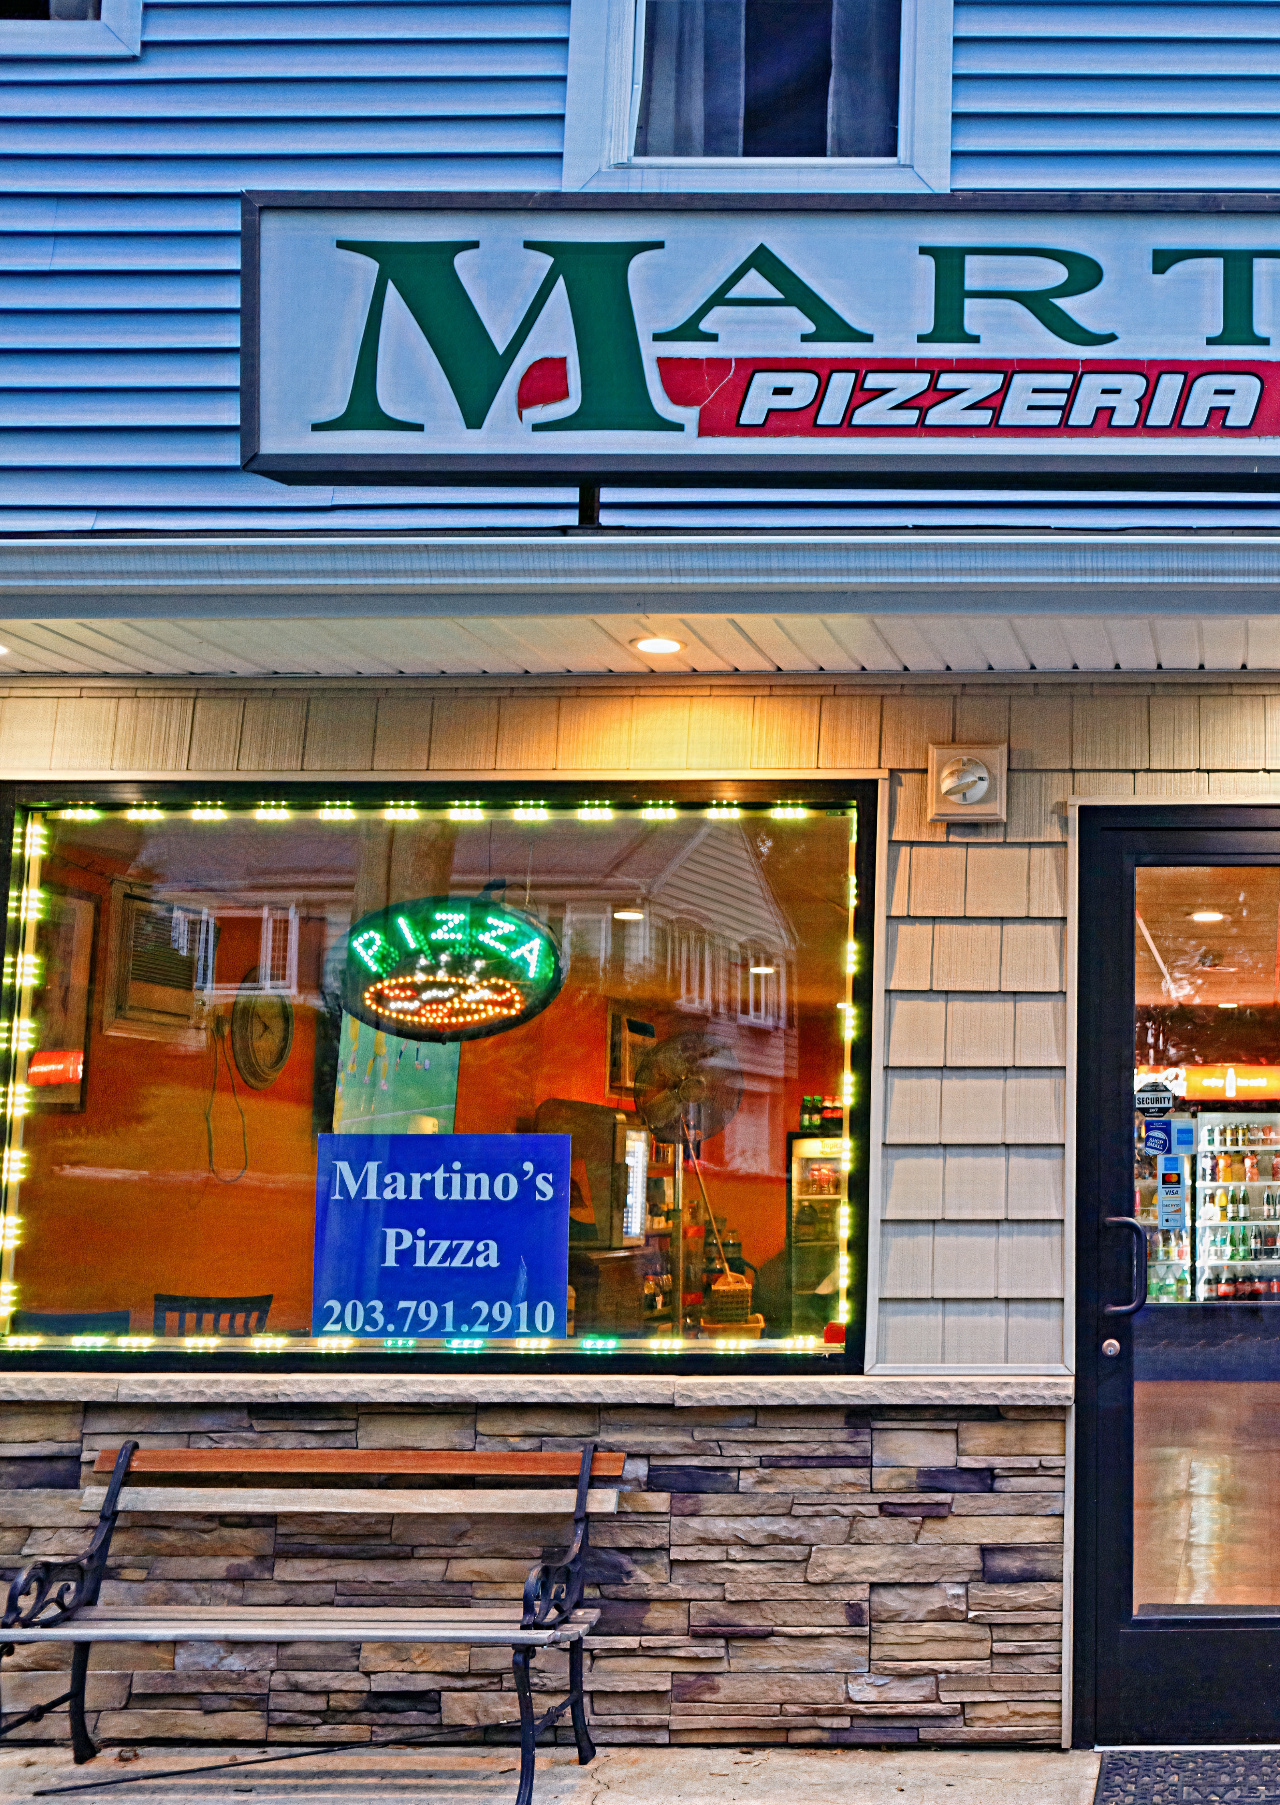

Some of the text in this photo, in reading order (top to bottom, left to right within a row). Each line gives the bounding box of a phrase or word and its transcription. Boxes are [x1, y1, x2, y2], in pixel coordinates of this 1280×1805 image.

[736, 368, 1264, 430] PIZZERIA
[353, 912, 543, 978] PIZZA
[1136, 1096, 1171, 1105] SECURITY
[331, 1161, 554, 1202] Martino's
[381, 1228, 500, 1268] Pizza
[323, 1299, 556, 1334] 203.791.2910
